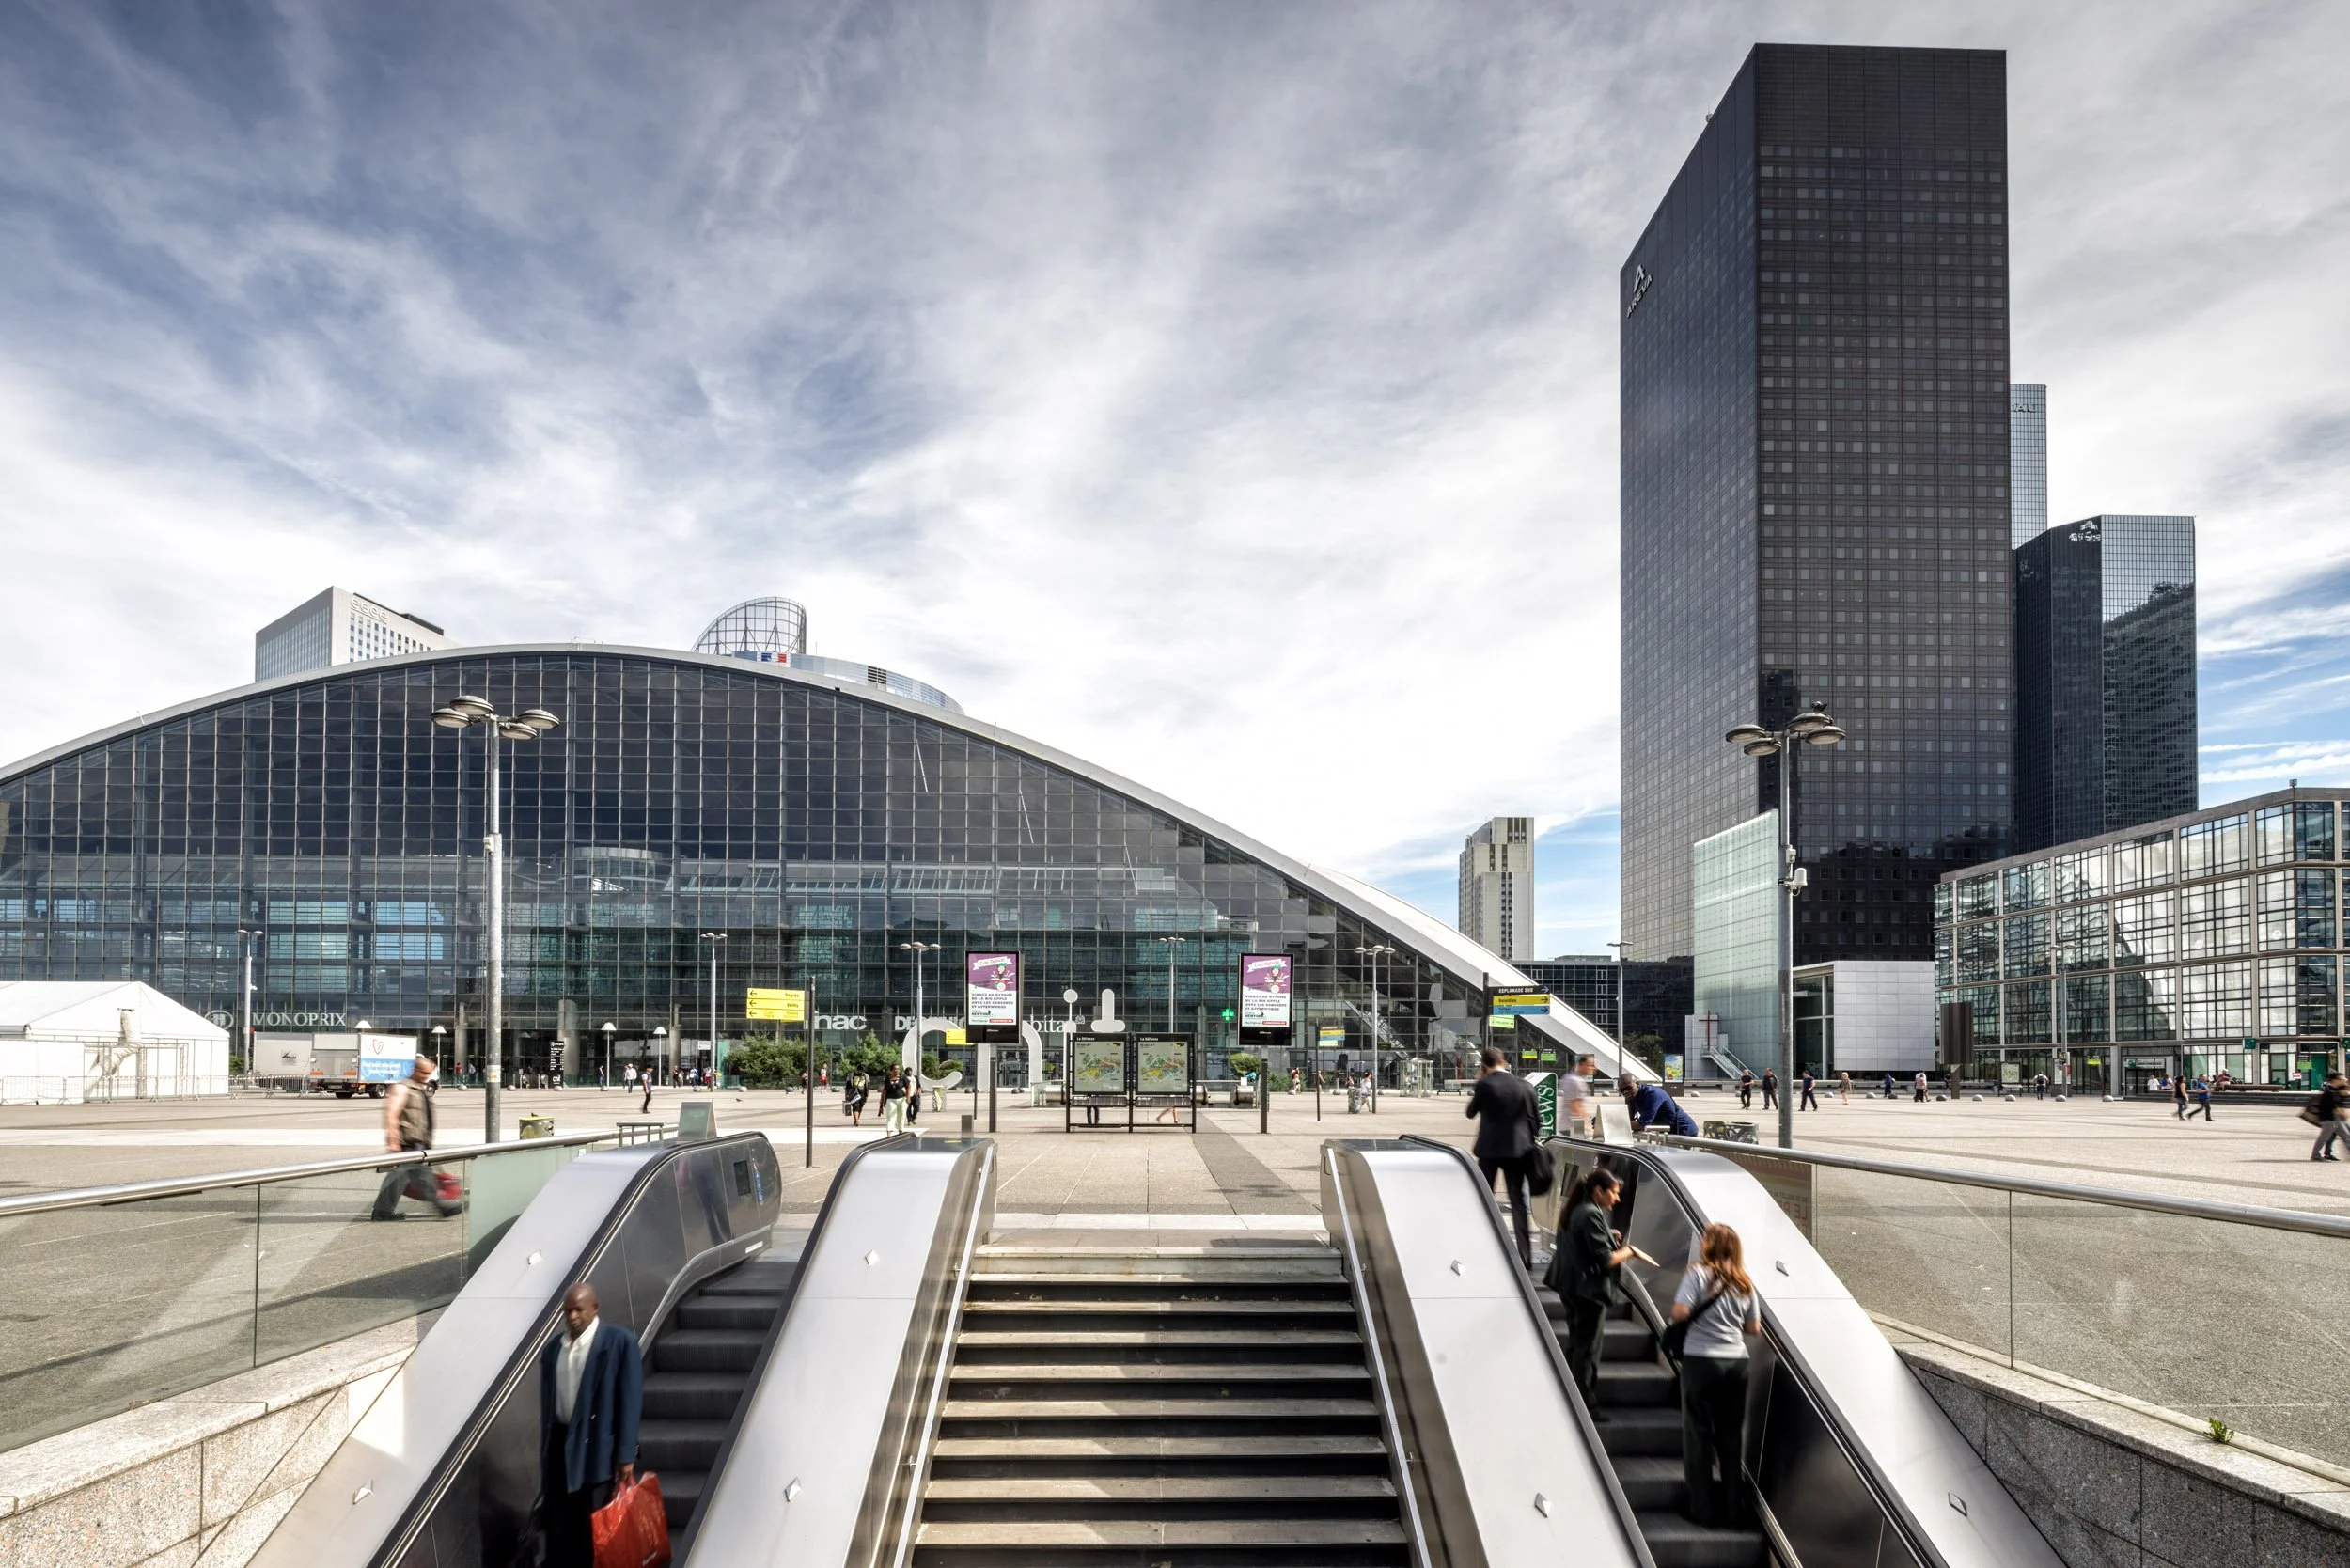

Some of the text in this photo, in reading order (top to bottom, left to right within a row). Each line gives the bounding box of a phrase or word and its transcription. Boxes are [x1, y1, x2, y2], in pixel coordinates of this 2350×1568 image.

[1626, 274, 1652, 318] AREVA
[252, 1012, 346, 1027] MONOPRIX
[807, 1011, 867, 1030] nac
[1030, 1014, 1065, 1032] bita
